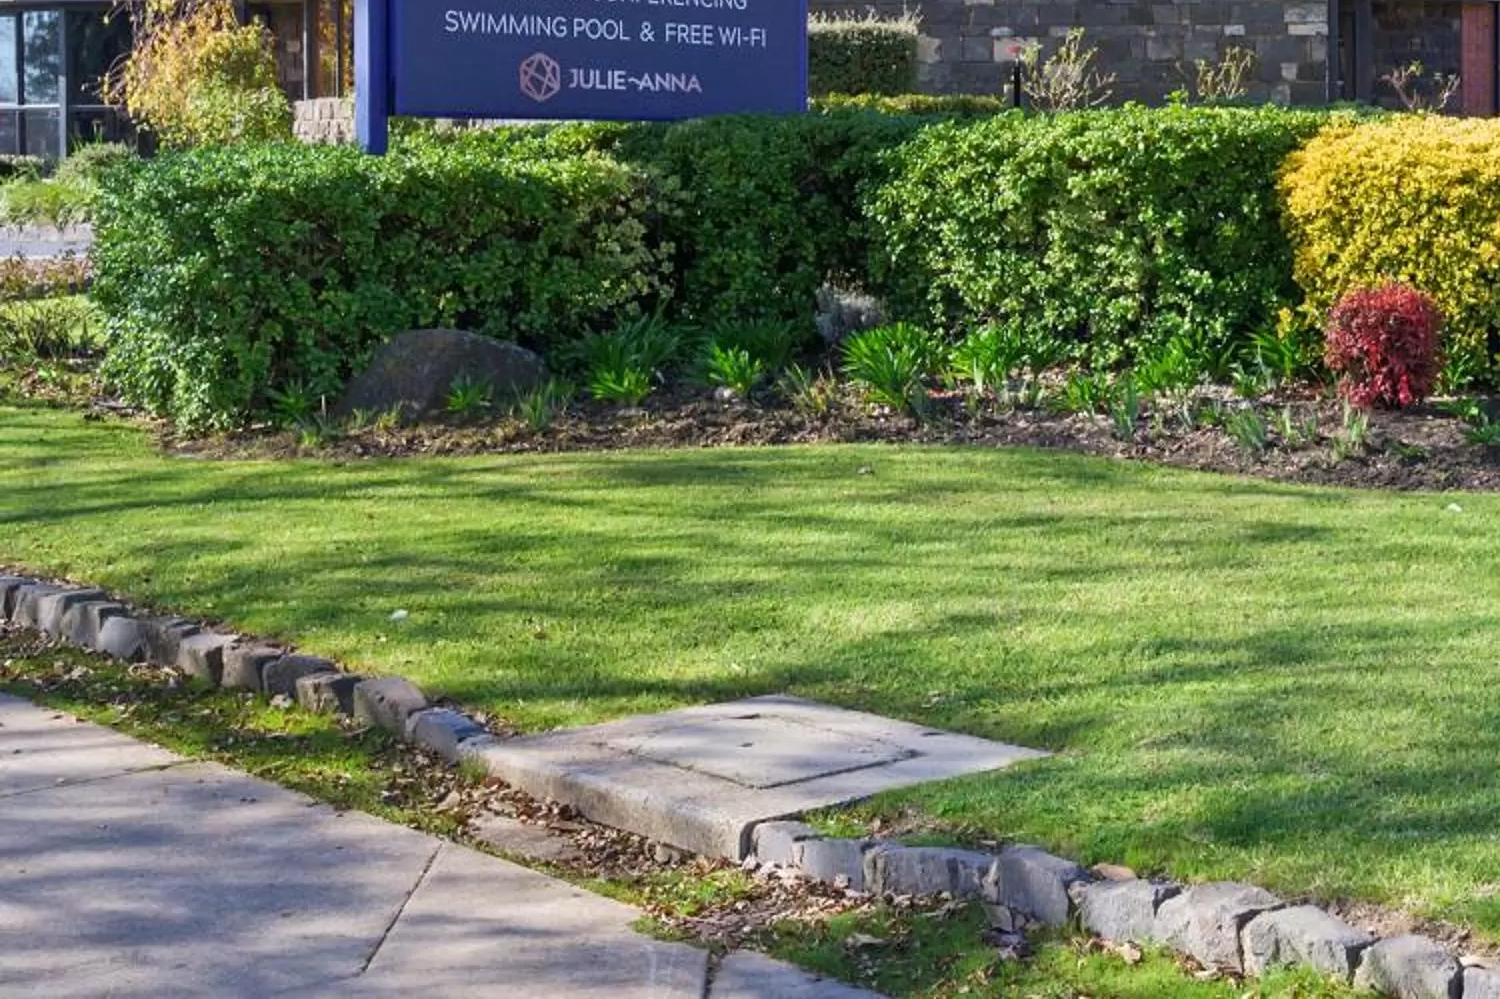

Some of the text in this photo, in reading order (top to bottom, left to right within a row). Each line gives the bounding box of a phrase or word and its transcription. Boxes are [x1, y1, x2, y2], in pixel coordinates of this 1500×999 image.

[444, 11, 766, 48] SWIMMING POOL & FREE WI-FI
